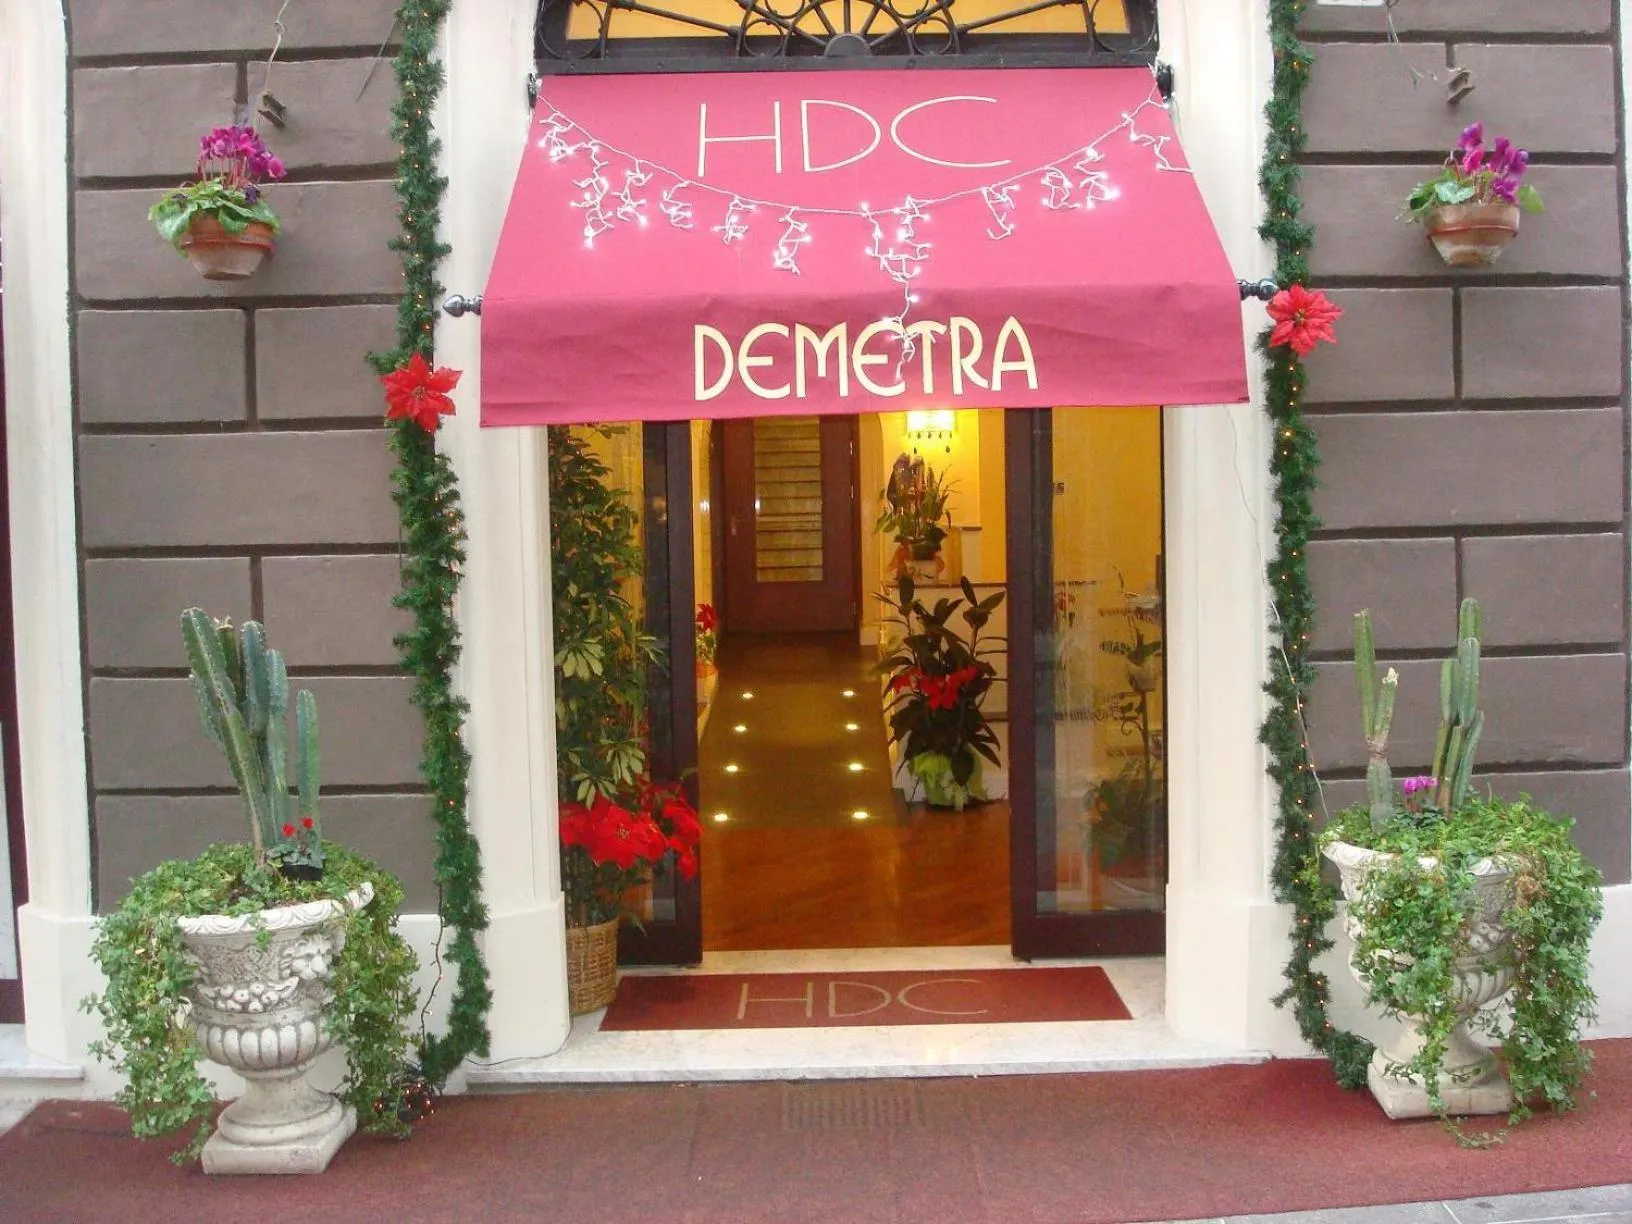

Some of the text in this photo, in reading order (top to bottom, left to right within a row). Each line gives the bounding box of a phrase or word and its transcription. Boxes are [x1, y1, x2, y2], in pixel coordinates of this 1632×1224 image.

[697, 95, 1012, 177] HDC
[694, 316, 1038, 401] DEMETRA
[738, 979, 989, 1020] HDC
